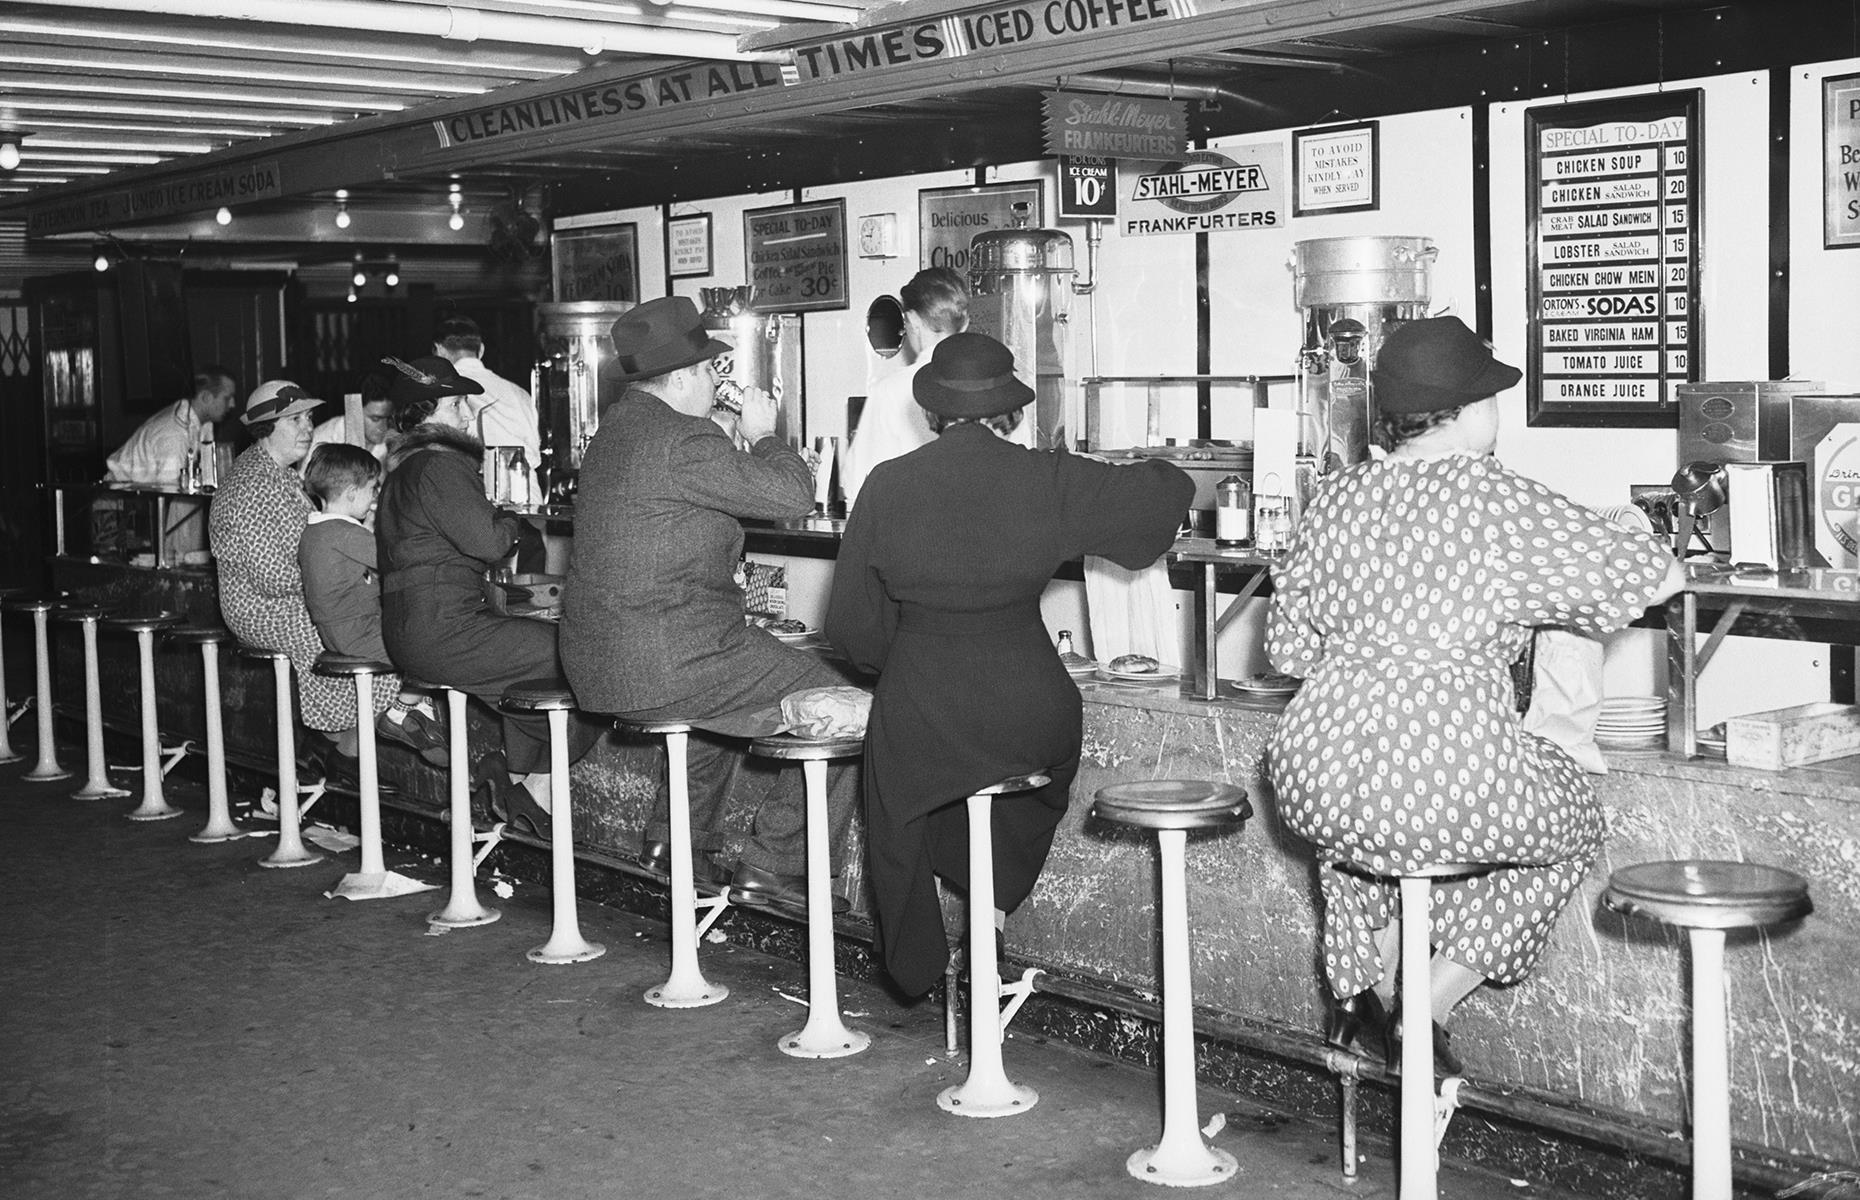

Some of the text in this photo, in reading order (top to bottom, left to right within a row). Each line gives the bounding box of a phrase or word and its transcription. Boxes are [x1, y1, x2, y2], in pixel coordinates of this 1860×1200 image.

[964, 9, 1034, 49] ICED
[450, 24, 944, 142] CLEANLINESS AT ALL TIMES
[1064, 130, 1176, 155] FRANKFURTERS
[1546, 128, 1608, 148] SPECIAL
[1312, 143, 1362, 157] TO AVOID
[1069, 167, 1107, 176] ICE CREAM
[1315, 156, 1358, 169] MISTAKES
[1557, 150, 1685, 174] CHICKEN SOUP 10
[189, 175, 235, 202] CREAM
[237, 169, 275, 195] SODA
[1140, 168, 1259, 197] STAHL-MEYER
[1308, 168, 1365, 183] KINDLY AY
[1313, 182, 1359, 195] WHEN SERVED
[1552, 180, 1685, 203] CHICKEN SALAD 20
[1605, 190, 1650, 200] SANDWICH
[753, 214, 833, 237] SPECIAL TO-DAY
[931, 211, 989, 228] Delicious
[1128, 211, 1276, 234] FRANKFURTERS
[1551, 209, 1684, 229] CRAB SALAD SANDWICH 15
[1551, 223, 1574, 231] MEAT
[1554, 238, 1684, 259] LOBSTER SALAD 15
[1604, 248, 1650, 257] SANDWICH
[1550, 267, 1685, 287] CHICKEN CHOW MEIN 20
[1587, 295, 1656, 315] SODAS
[1675, 297, 1686, 310] 10
[1549, 326, 1687, 342] BAKED VIRGINIA HAM 15
[1563, 355, 1686, 369] TOMATO JUICE 10
[1561, 384, 1605, 397] ORANGE
[1613, 384, 1645, 397] JUICE
